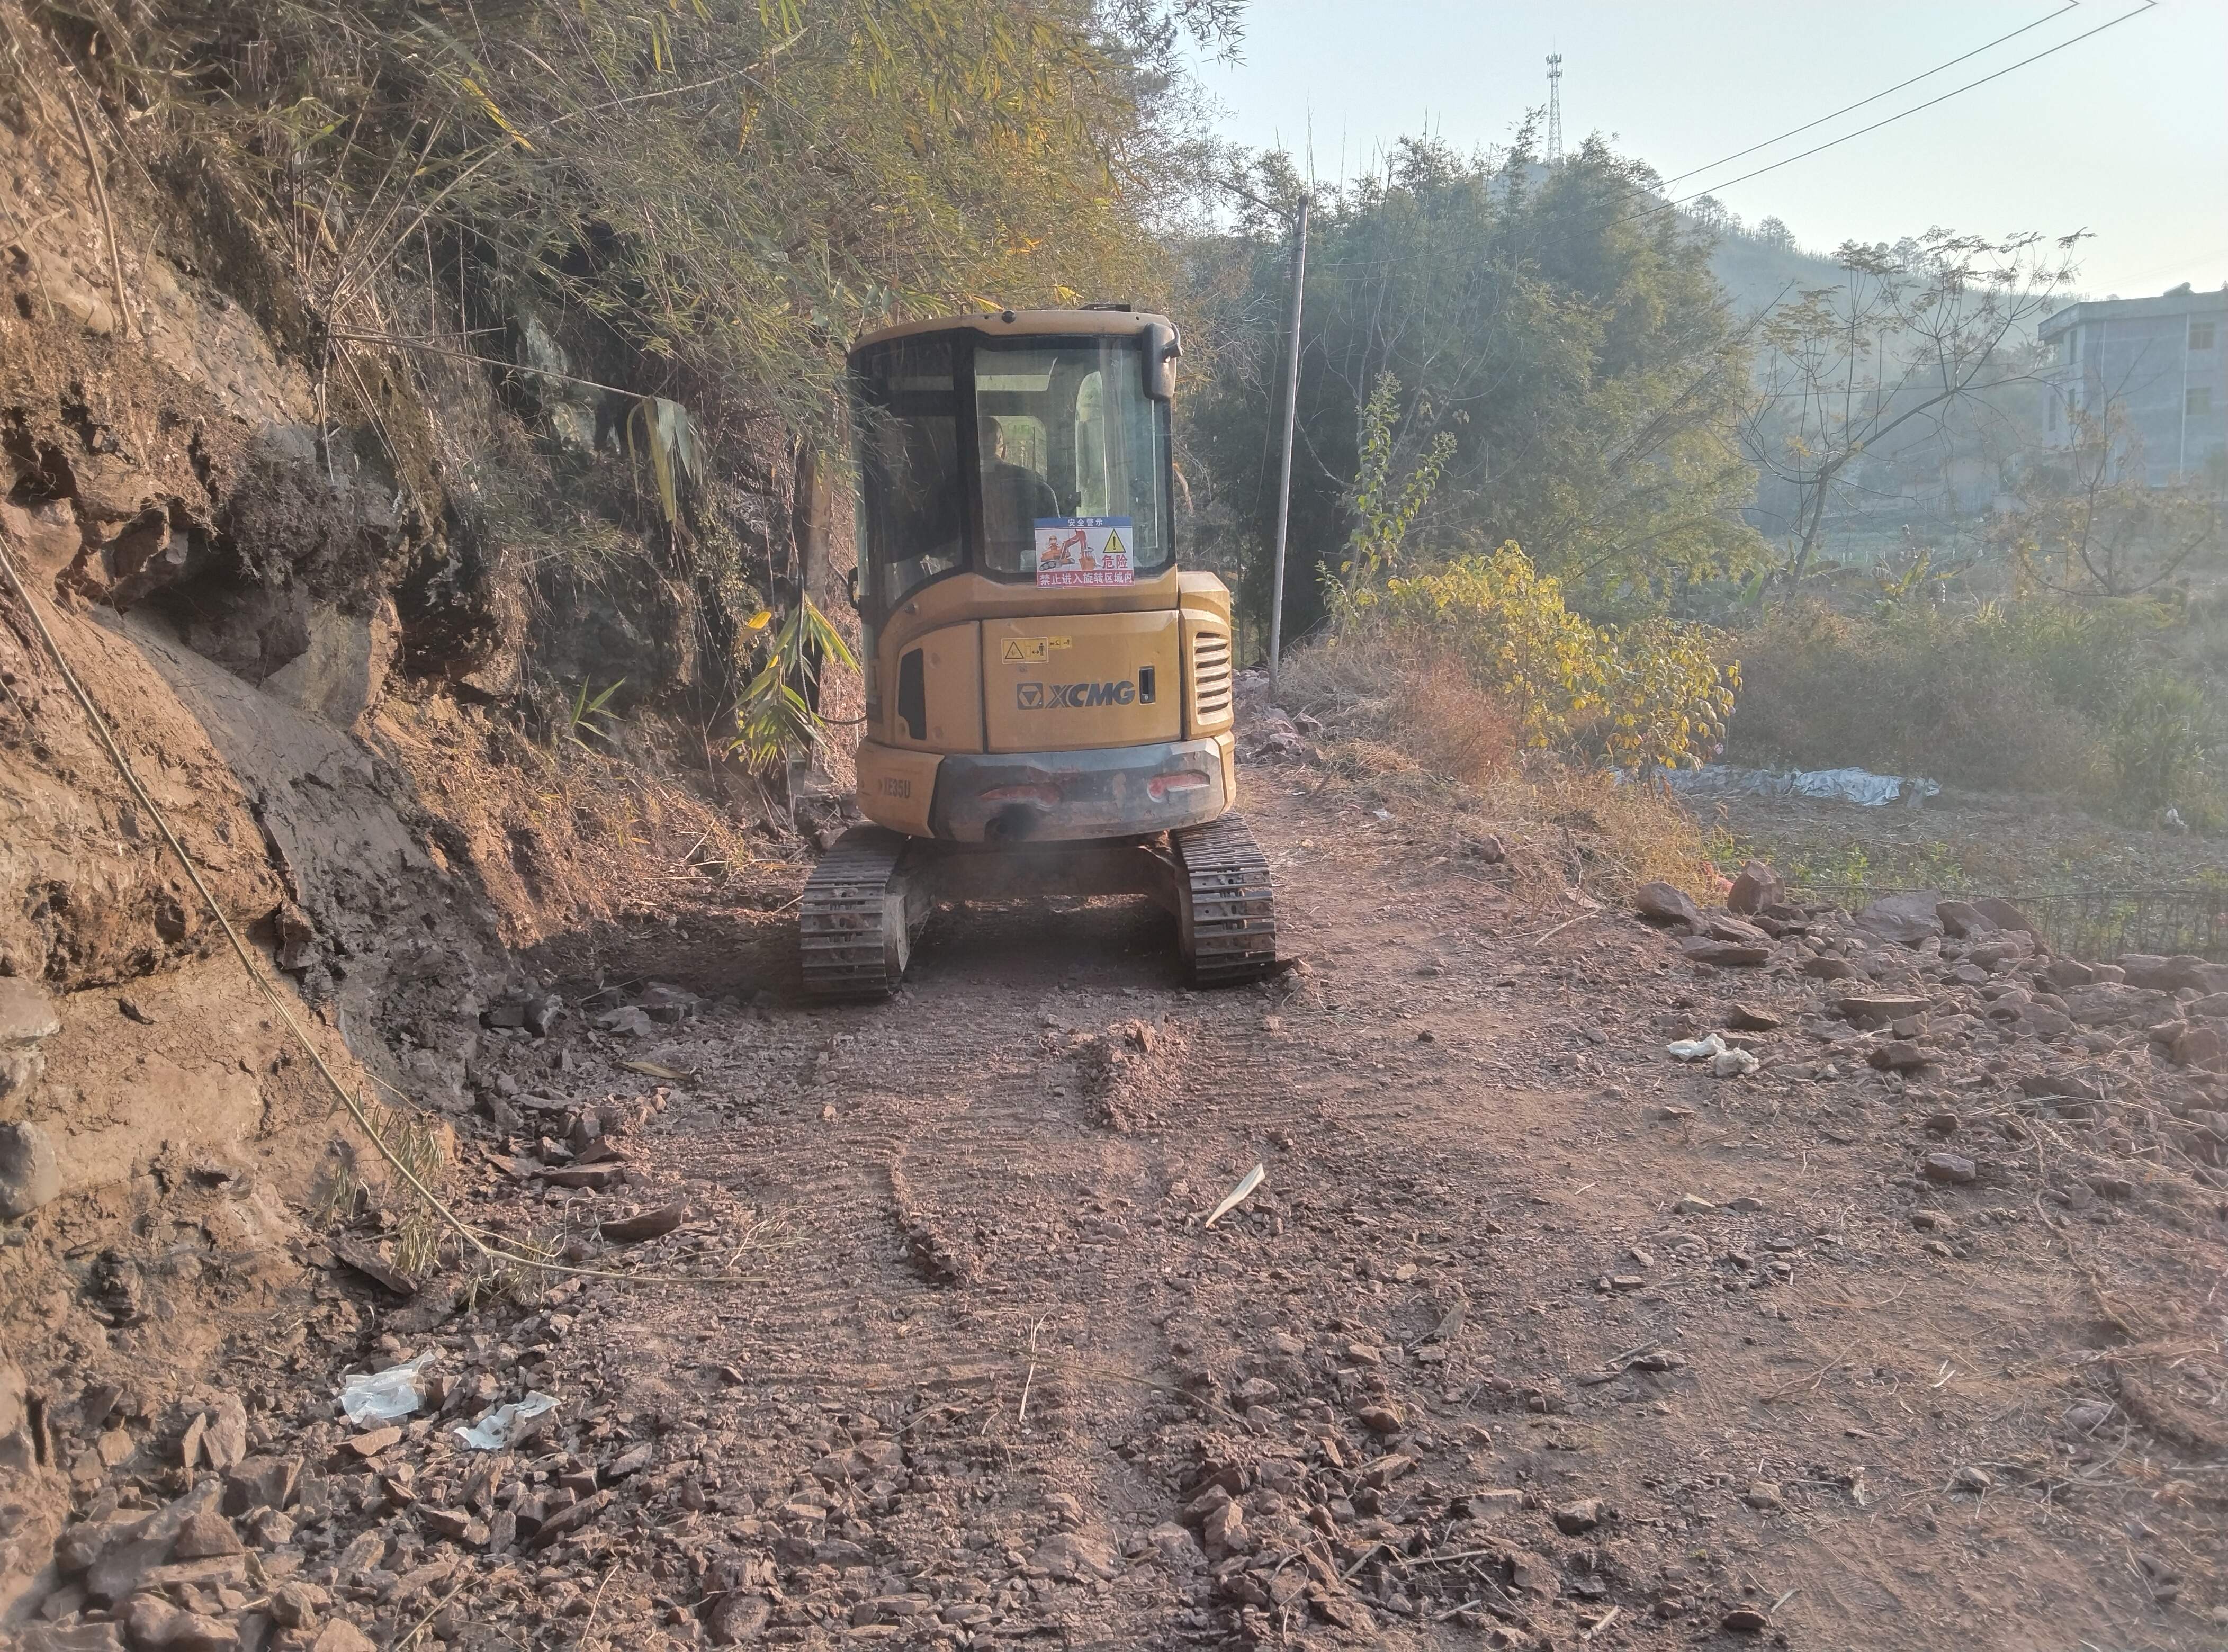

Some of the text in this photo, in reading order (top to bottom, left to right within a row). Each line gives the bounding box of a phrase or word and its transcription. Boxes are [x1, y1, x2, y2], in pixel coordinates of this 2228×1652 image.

[1102, 554, 1128, 569] 危险
[1040, 572, 1132, 585] 禁止进入旋转区域内
[1045, 681, 1136, 709] XCMG
